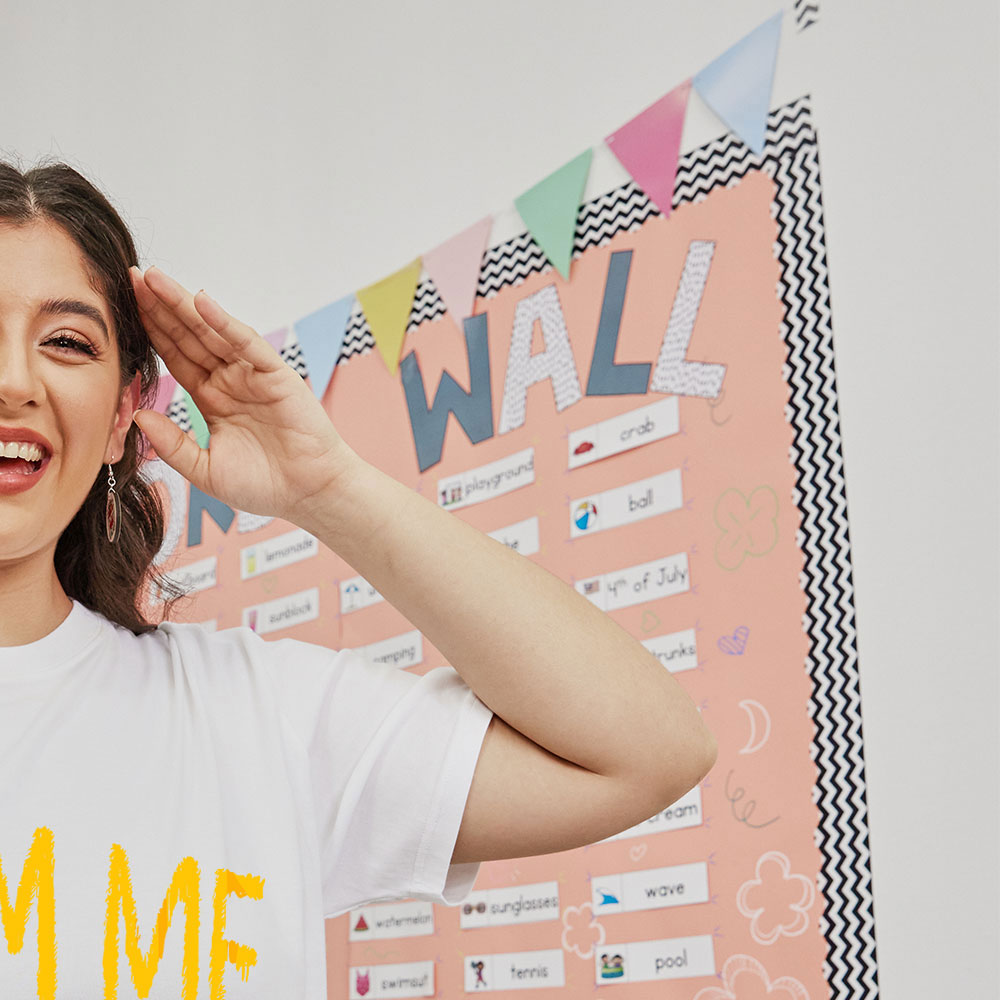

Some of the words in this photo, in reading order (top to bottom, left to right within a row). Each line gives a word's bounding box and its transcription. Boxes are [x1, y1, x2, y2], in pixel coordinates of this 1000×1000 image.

[401, 241, 727, 473] WALL
[620, 416, 654, 440] crab
[465, 456, 534, 497] playground
[628, 489, 653, 511] ball
[633, 573, 649, 592] of
[657, 565, 687, 586] July
[645, 882, 684, 898] wave
[490, 895, 558, 916] sunglasses
[511, 964, 548, 980] tennis
[655, 949, 688, 973] pool
